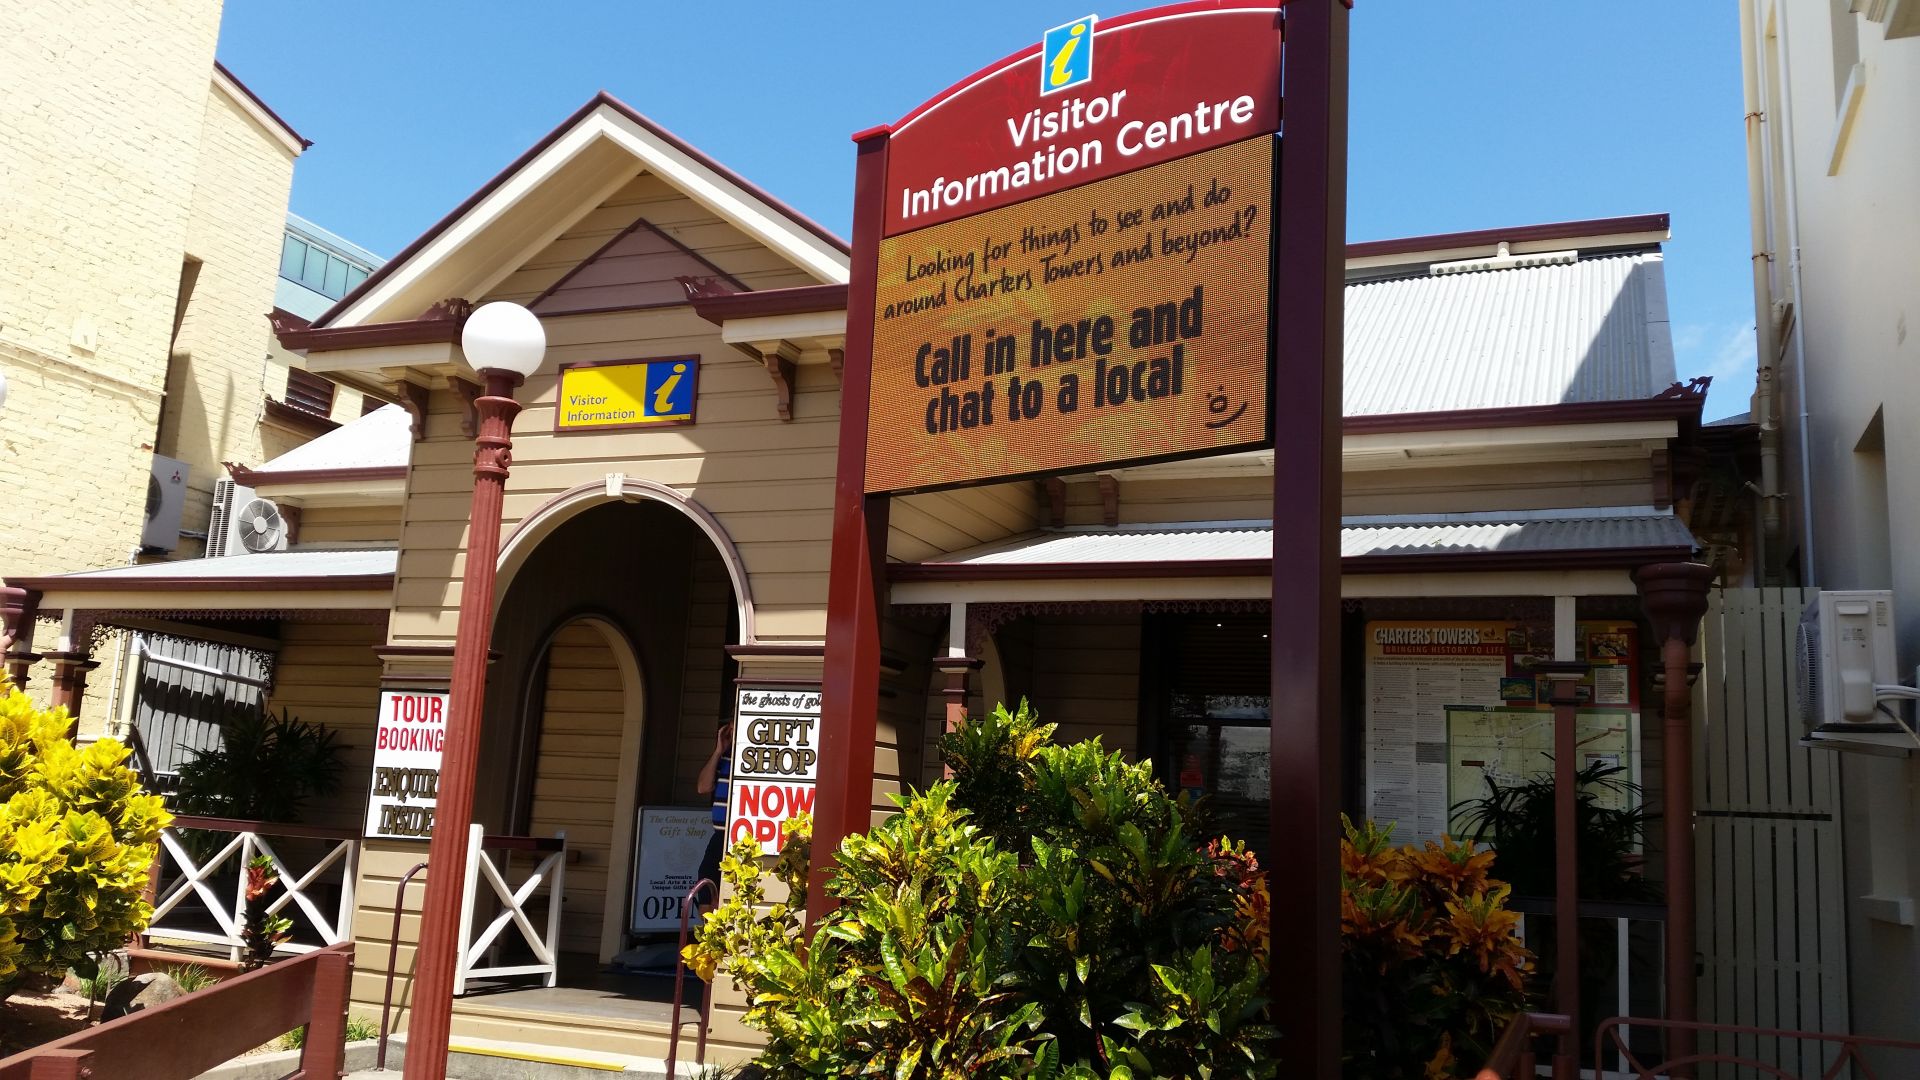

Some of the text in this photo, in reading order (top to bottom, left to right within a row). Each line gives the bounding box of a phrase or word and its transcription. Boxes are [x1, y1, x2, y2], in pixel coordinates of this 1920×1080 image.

[1007, 88, 1127, 148] Visitor
[902, 94, 1256, 219] Information Centre
[905, 177, 1232, 283] Looking for things to see and do
[883, 204, 1258, 320] around Charters Towers and beyond?
[914, 285, 1205, 389] Call in here and
[569, 394, 608, 406] Visitor
[924, 342, 1185, 436] chat to a local
[567, 408, 635, 422] Information
[1375, 628, 1480, 645] CHARTERS TOWERS
[1431, 646, 1468, 654] HISTORY
[1486, 646, 1505, 654] LIFE
[392, 695, 442, 723] TOUR
[742, 692, 822, 710] the ghosts of gol
[378, 727, 444, 753] BOOKING
[747, 718, 814, 746] GIFT
[741, 746, 816, 775] SHOP
[372, 766, 441, 803] ENQUIR
[739, 785, 816, 818] NOW
[660, 827, 707, 839] Gift Shop
